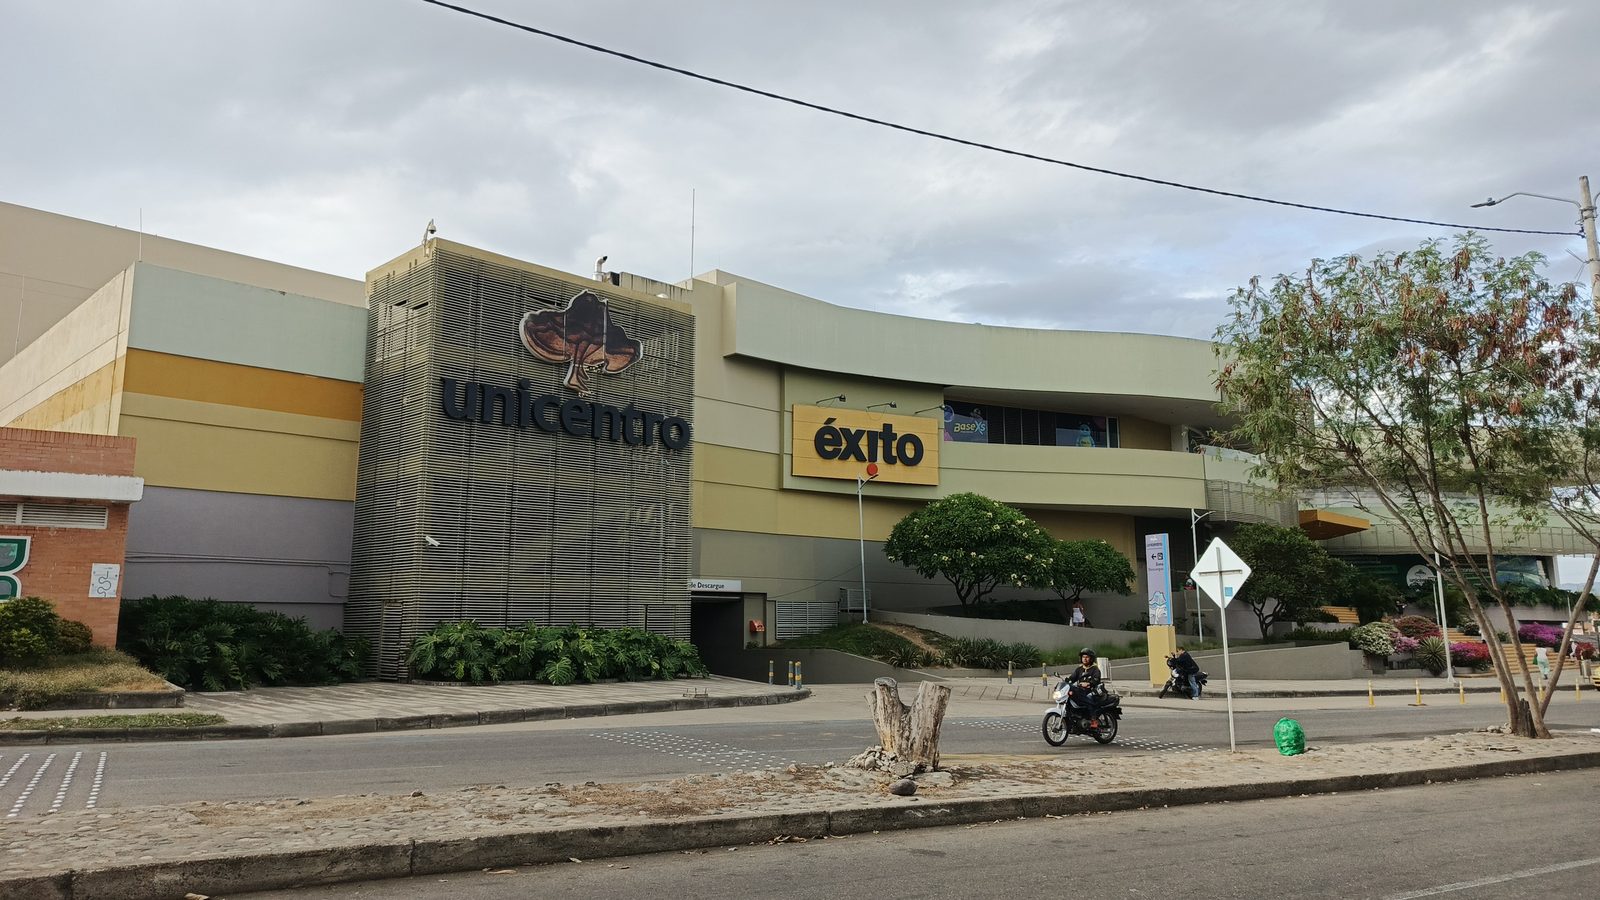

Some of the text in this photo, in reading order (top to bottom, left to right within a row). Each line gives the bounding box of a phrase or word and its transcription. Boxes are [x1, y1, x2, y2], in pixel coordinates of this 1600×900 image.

[441, 377, 692, 450] unicentro
[814, 417, 925, 475] éxito
[697, 581, 725, 590] Descargue
